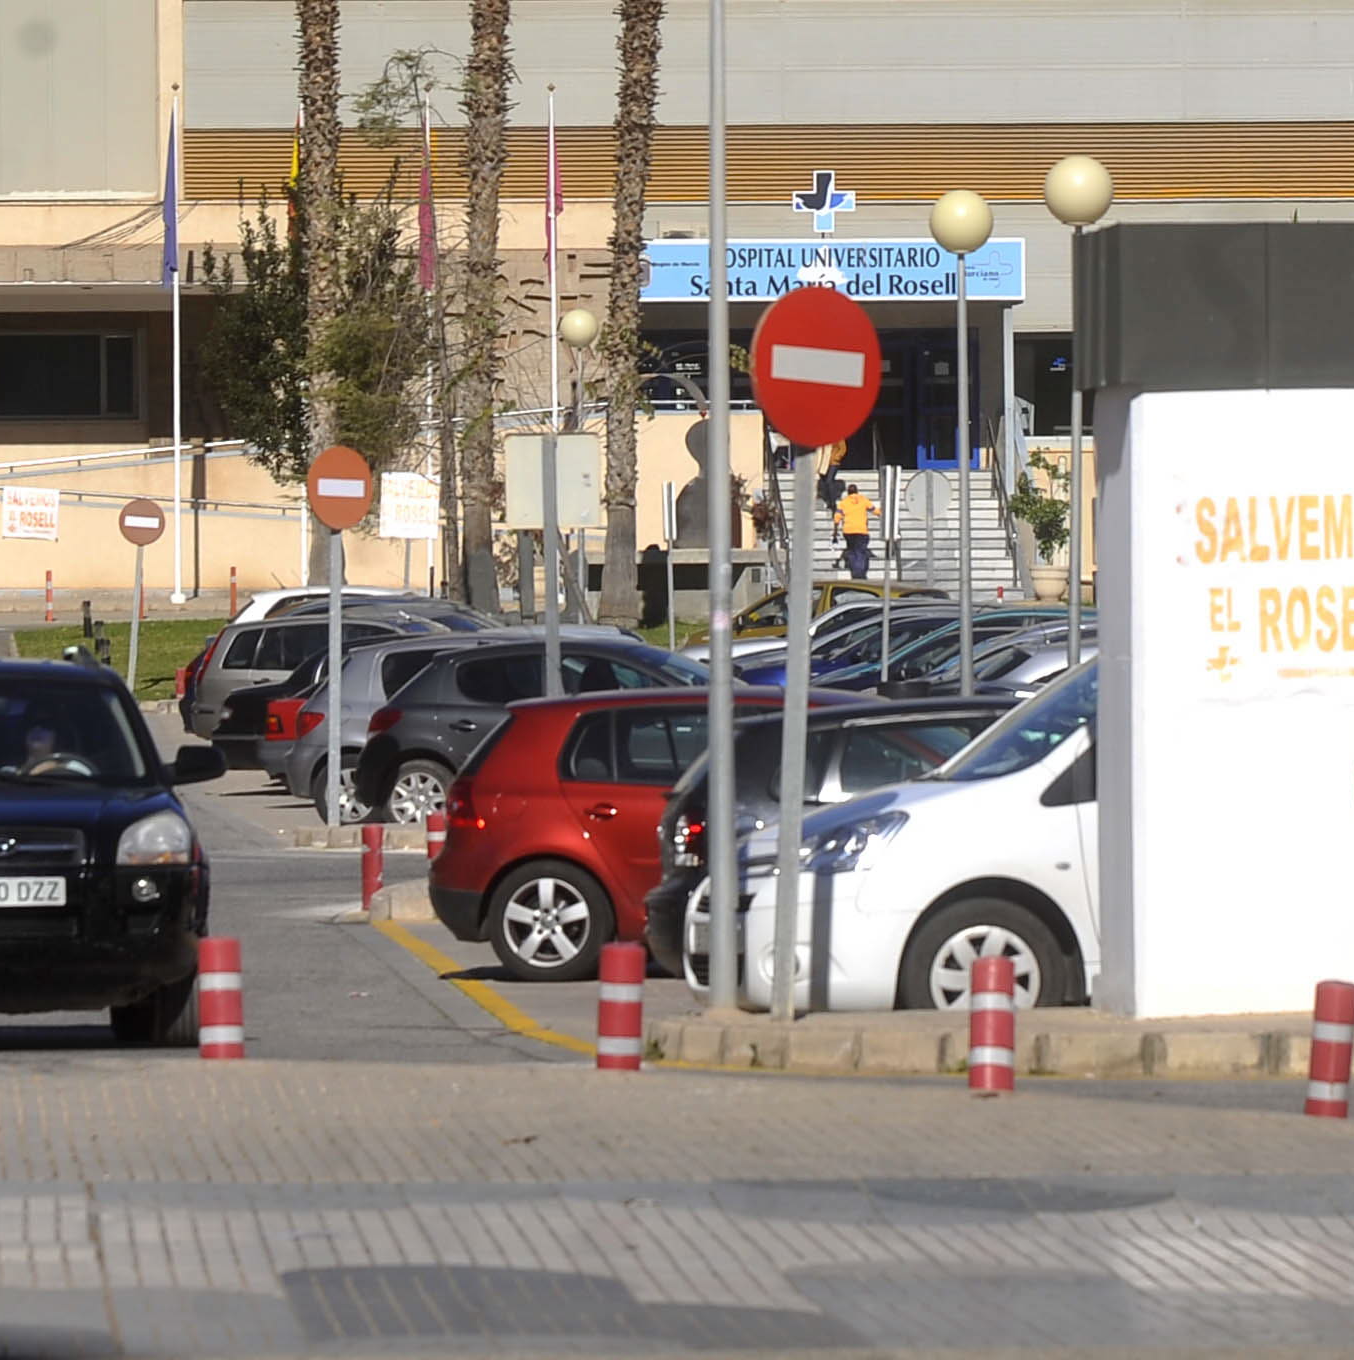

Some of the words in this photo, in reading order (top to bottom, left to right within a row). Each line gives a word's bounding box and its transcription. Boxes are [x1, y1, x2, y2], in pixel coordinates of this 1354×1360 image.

[709, 247, 796, 268] OSPITAL
[801, 247, 940, 268] UNIVERSITARIO
[846, 272, 881, 296] del
[889, 272, 957, 296] Rosell
[20, 511, 55, 529] ROSELL
[1209, 587, 1242, 632] EL
[16, 881, 61, 902] DZZ
